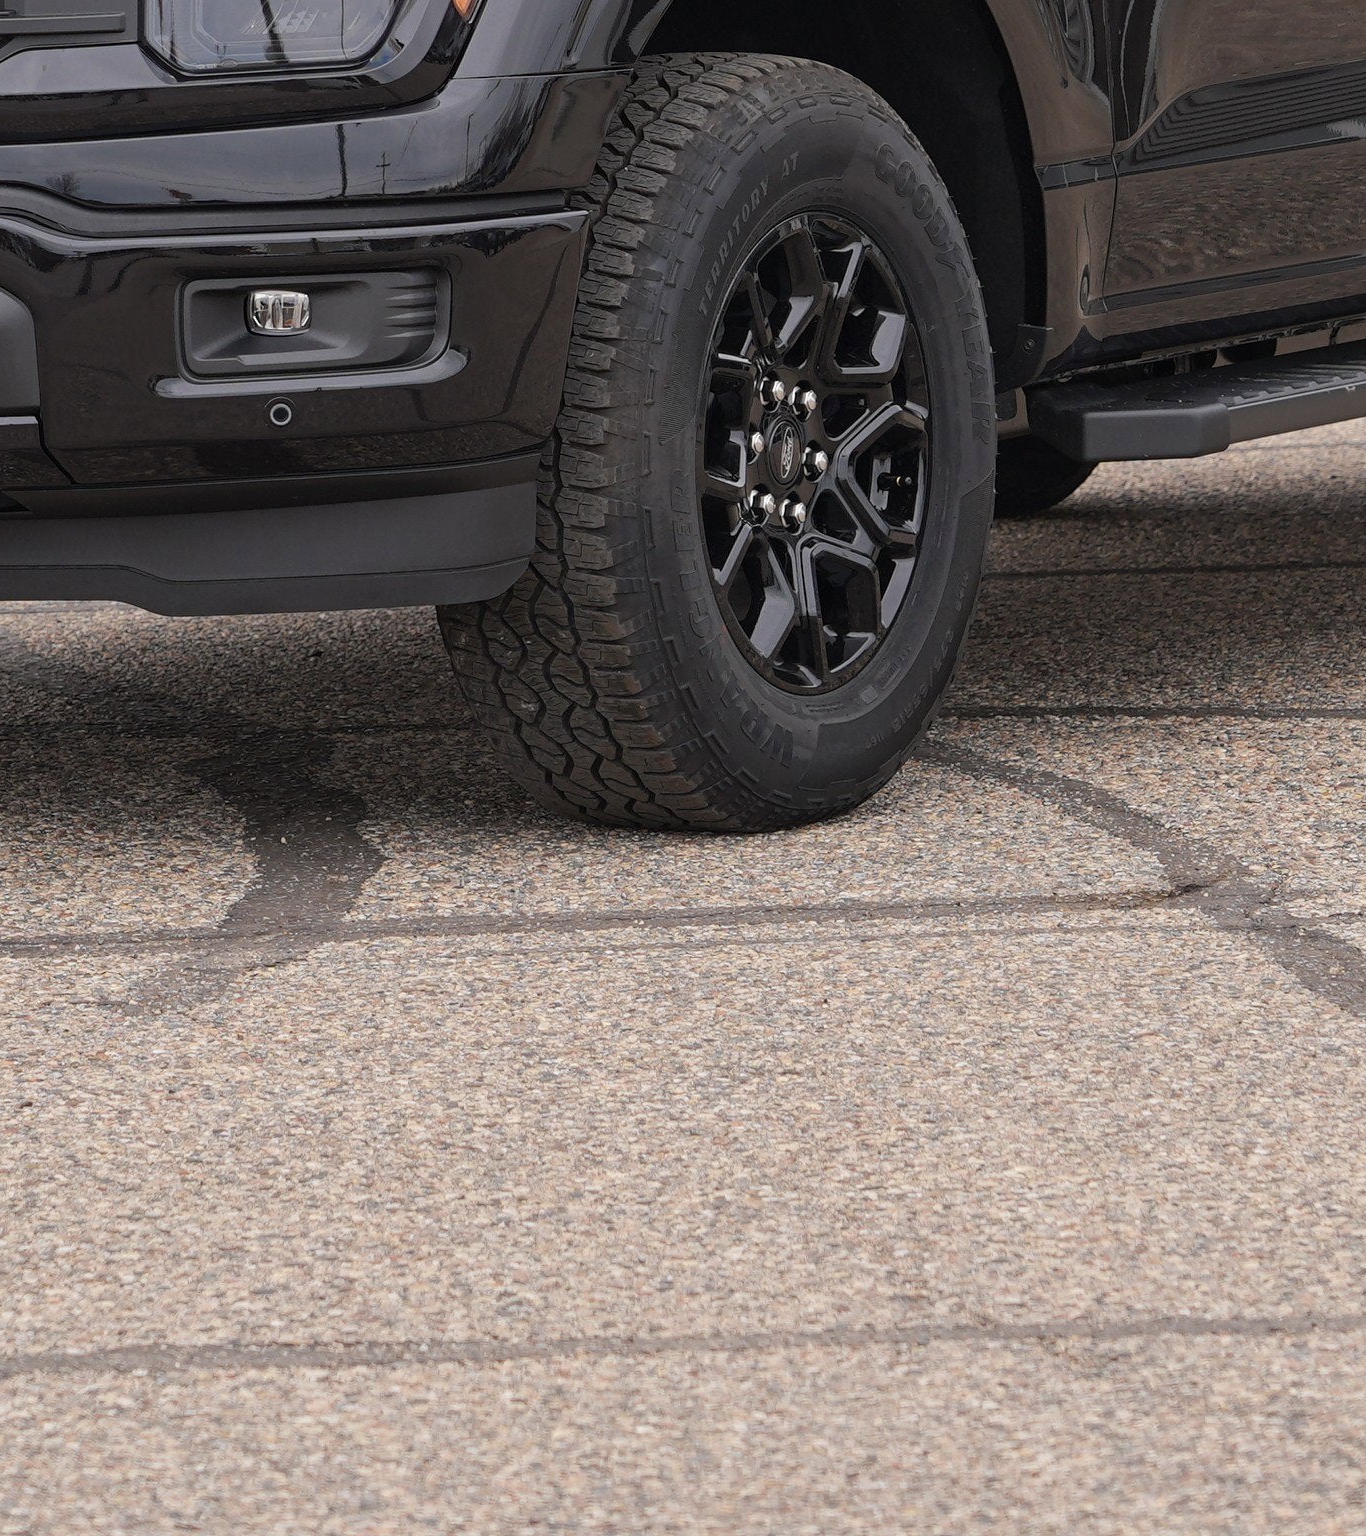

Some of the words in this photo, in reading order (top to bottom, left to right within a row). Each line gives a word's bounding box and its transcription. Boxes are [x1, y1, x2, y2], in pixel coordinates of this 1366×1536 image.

[697, 175, 769, 318] TERRITORY
[780, 150, 801, 180] AT
[874, 142, 991, 446] GOODYEAR
